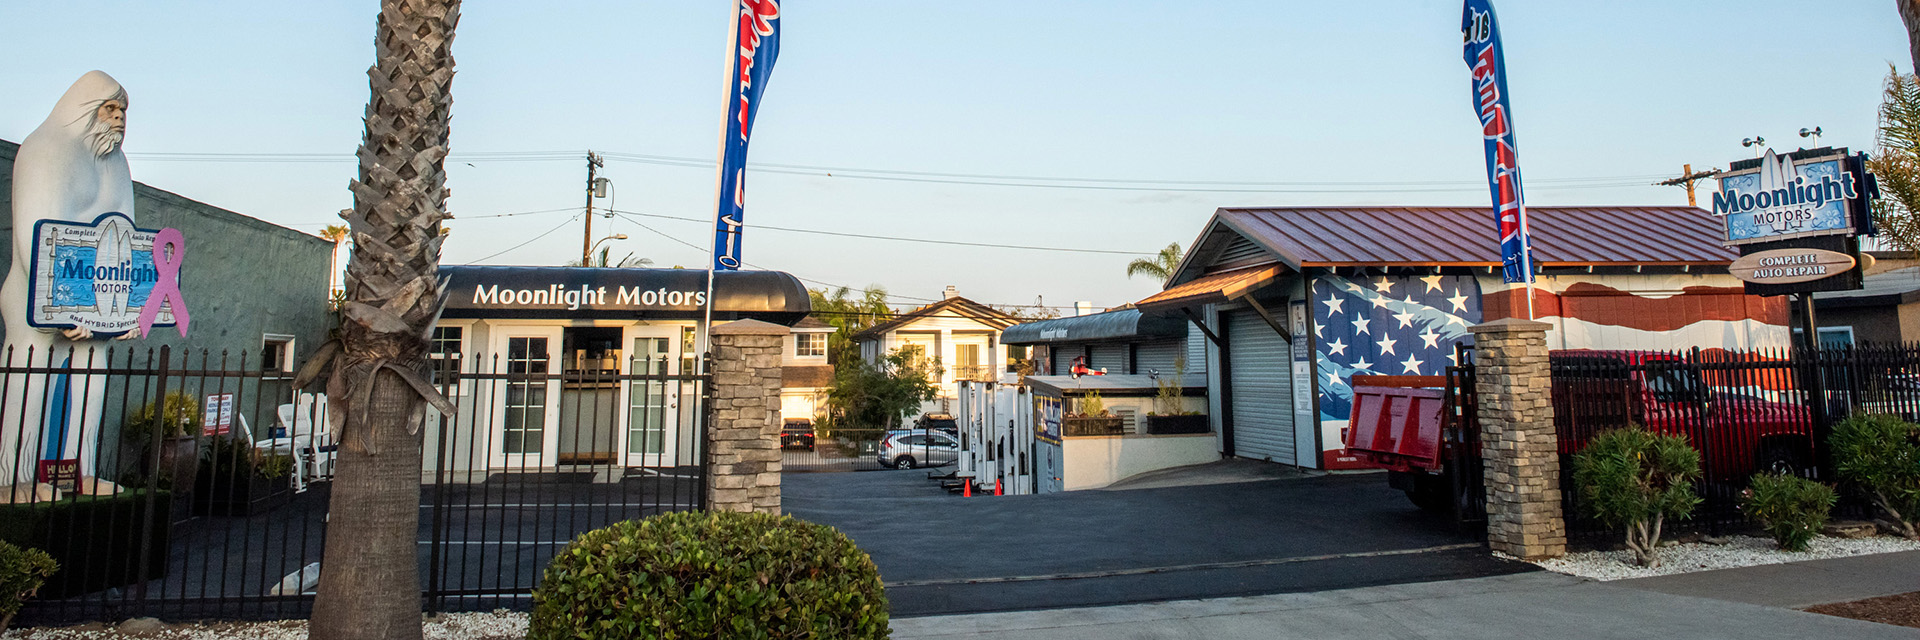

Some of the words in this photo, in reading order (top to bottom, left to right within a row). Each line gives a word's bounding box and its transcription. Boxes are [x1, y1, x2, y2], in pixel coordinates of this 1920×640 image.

[1711, 171, 1858, 216] Moonlight
[1753, 207, 1813, 226] MOTORS
[64, 227, 96, 237] Complete
[1759, 253, 1818, 267] COMPLETE
[1753, 268, 1785, 279] AUTO
[1785, 265, 1826, 277] REPAIR
[91, 283, 134, 294] MOTORS
[472, 283, 607, 311] Moonlight
[615, 285, 707, 306] Motors
[69, 314, 84, 323] and
[84, 319, 115, 329] HYBRID
[116, 318, 140, 329] Special
